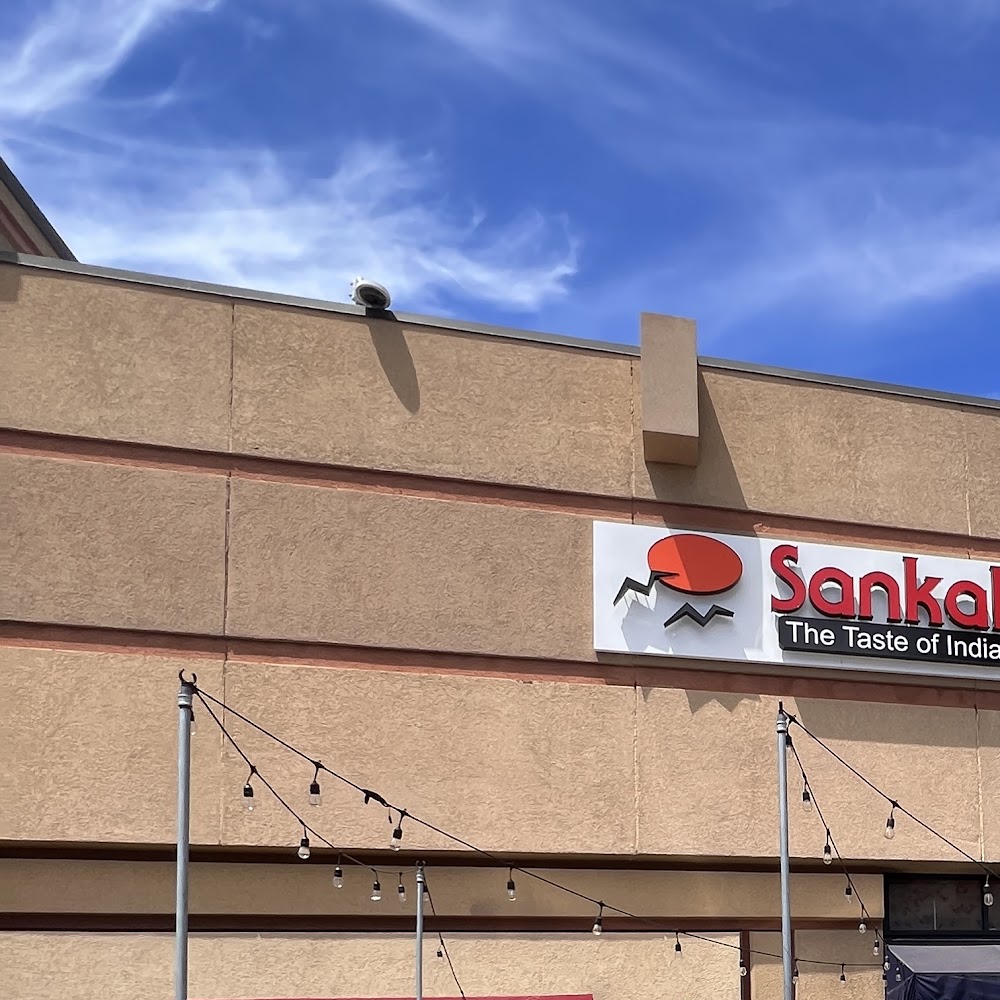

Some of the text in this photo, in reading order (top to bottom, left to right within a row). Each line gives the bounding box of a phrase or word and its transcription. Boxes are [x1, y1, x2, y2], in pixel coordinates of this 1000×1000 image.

[785, 620, 835, 646] The
[842, 625, 909, 652] Taste
[916, 633, 939, 655] of
